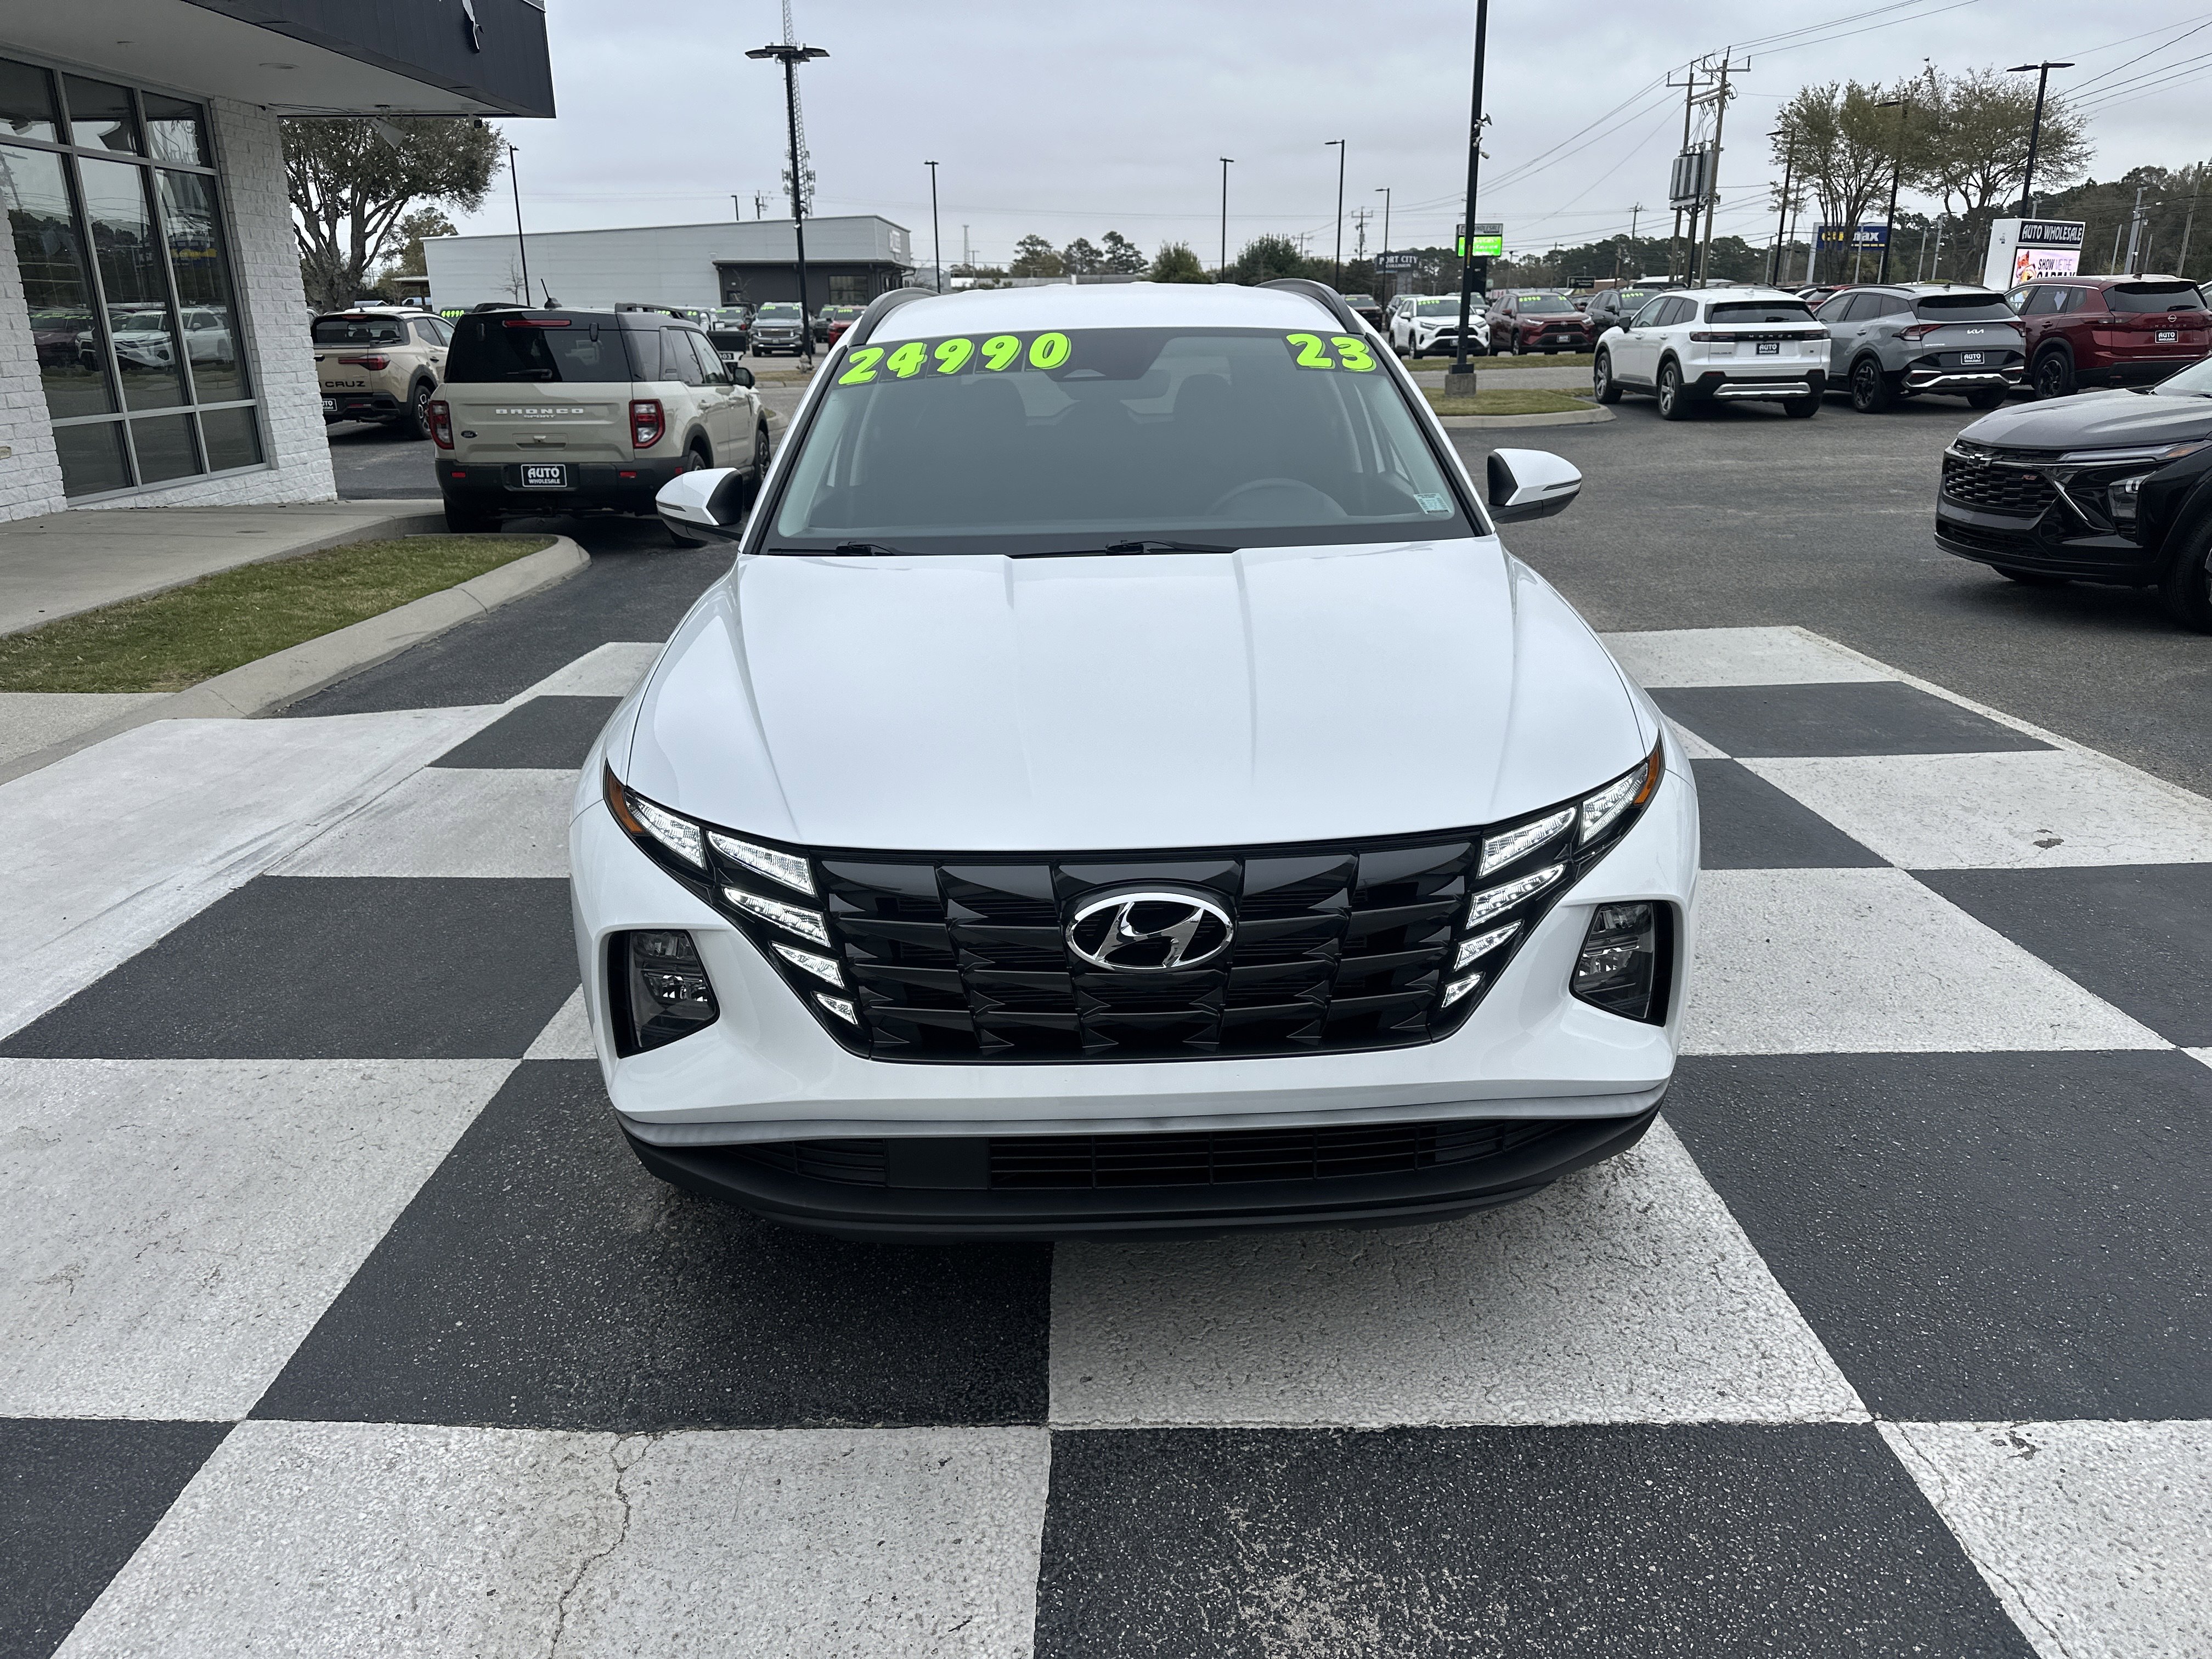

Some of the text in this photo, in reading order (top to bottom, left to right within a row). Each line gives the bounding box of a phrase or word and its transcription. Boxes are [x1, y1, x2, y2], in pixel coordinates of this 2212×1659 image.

[2022, 224, 2042, 240] AUTO
[2044, 225, 2083, 241] WHOLESALE
[1401, 255, 1418, 263] CITY
[2038, 258, 2055, 270] SHOW
[838, 332, 1072, 386] 24990
[1286, 333, 1376, 373] 23
[527, 468, 560, 478] AUTO
